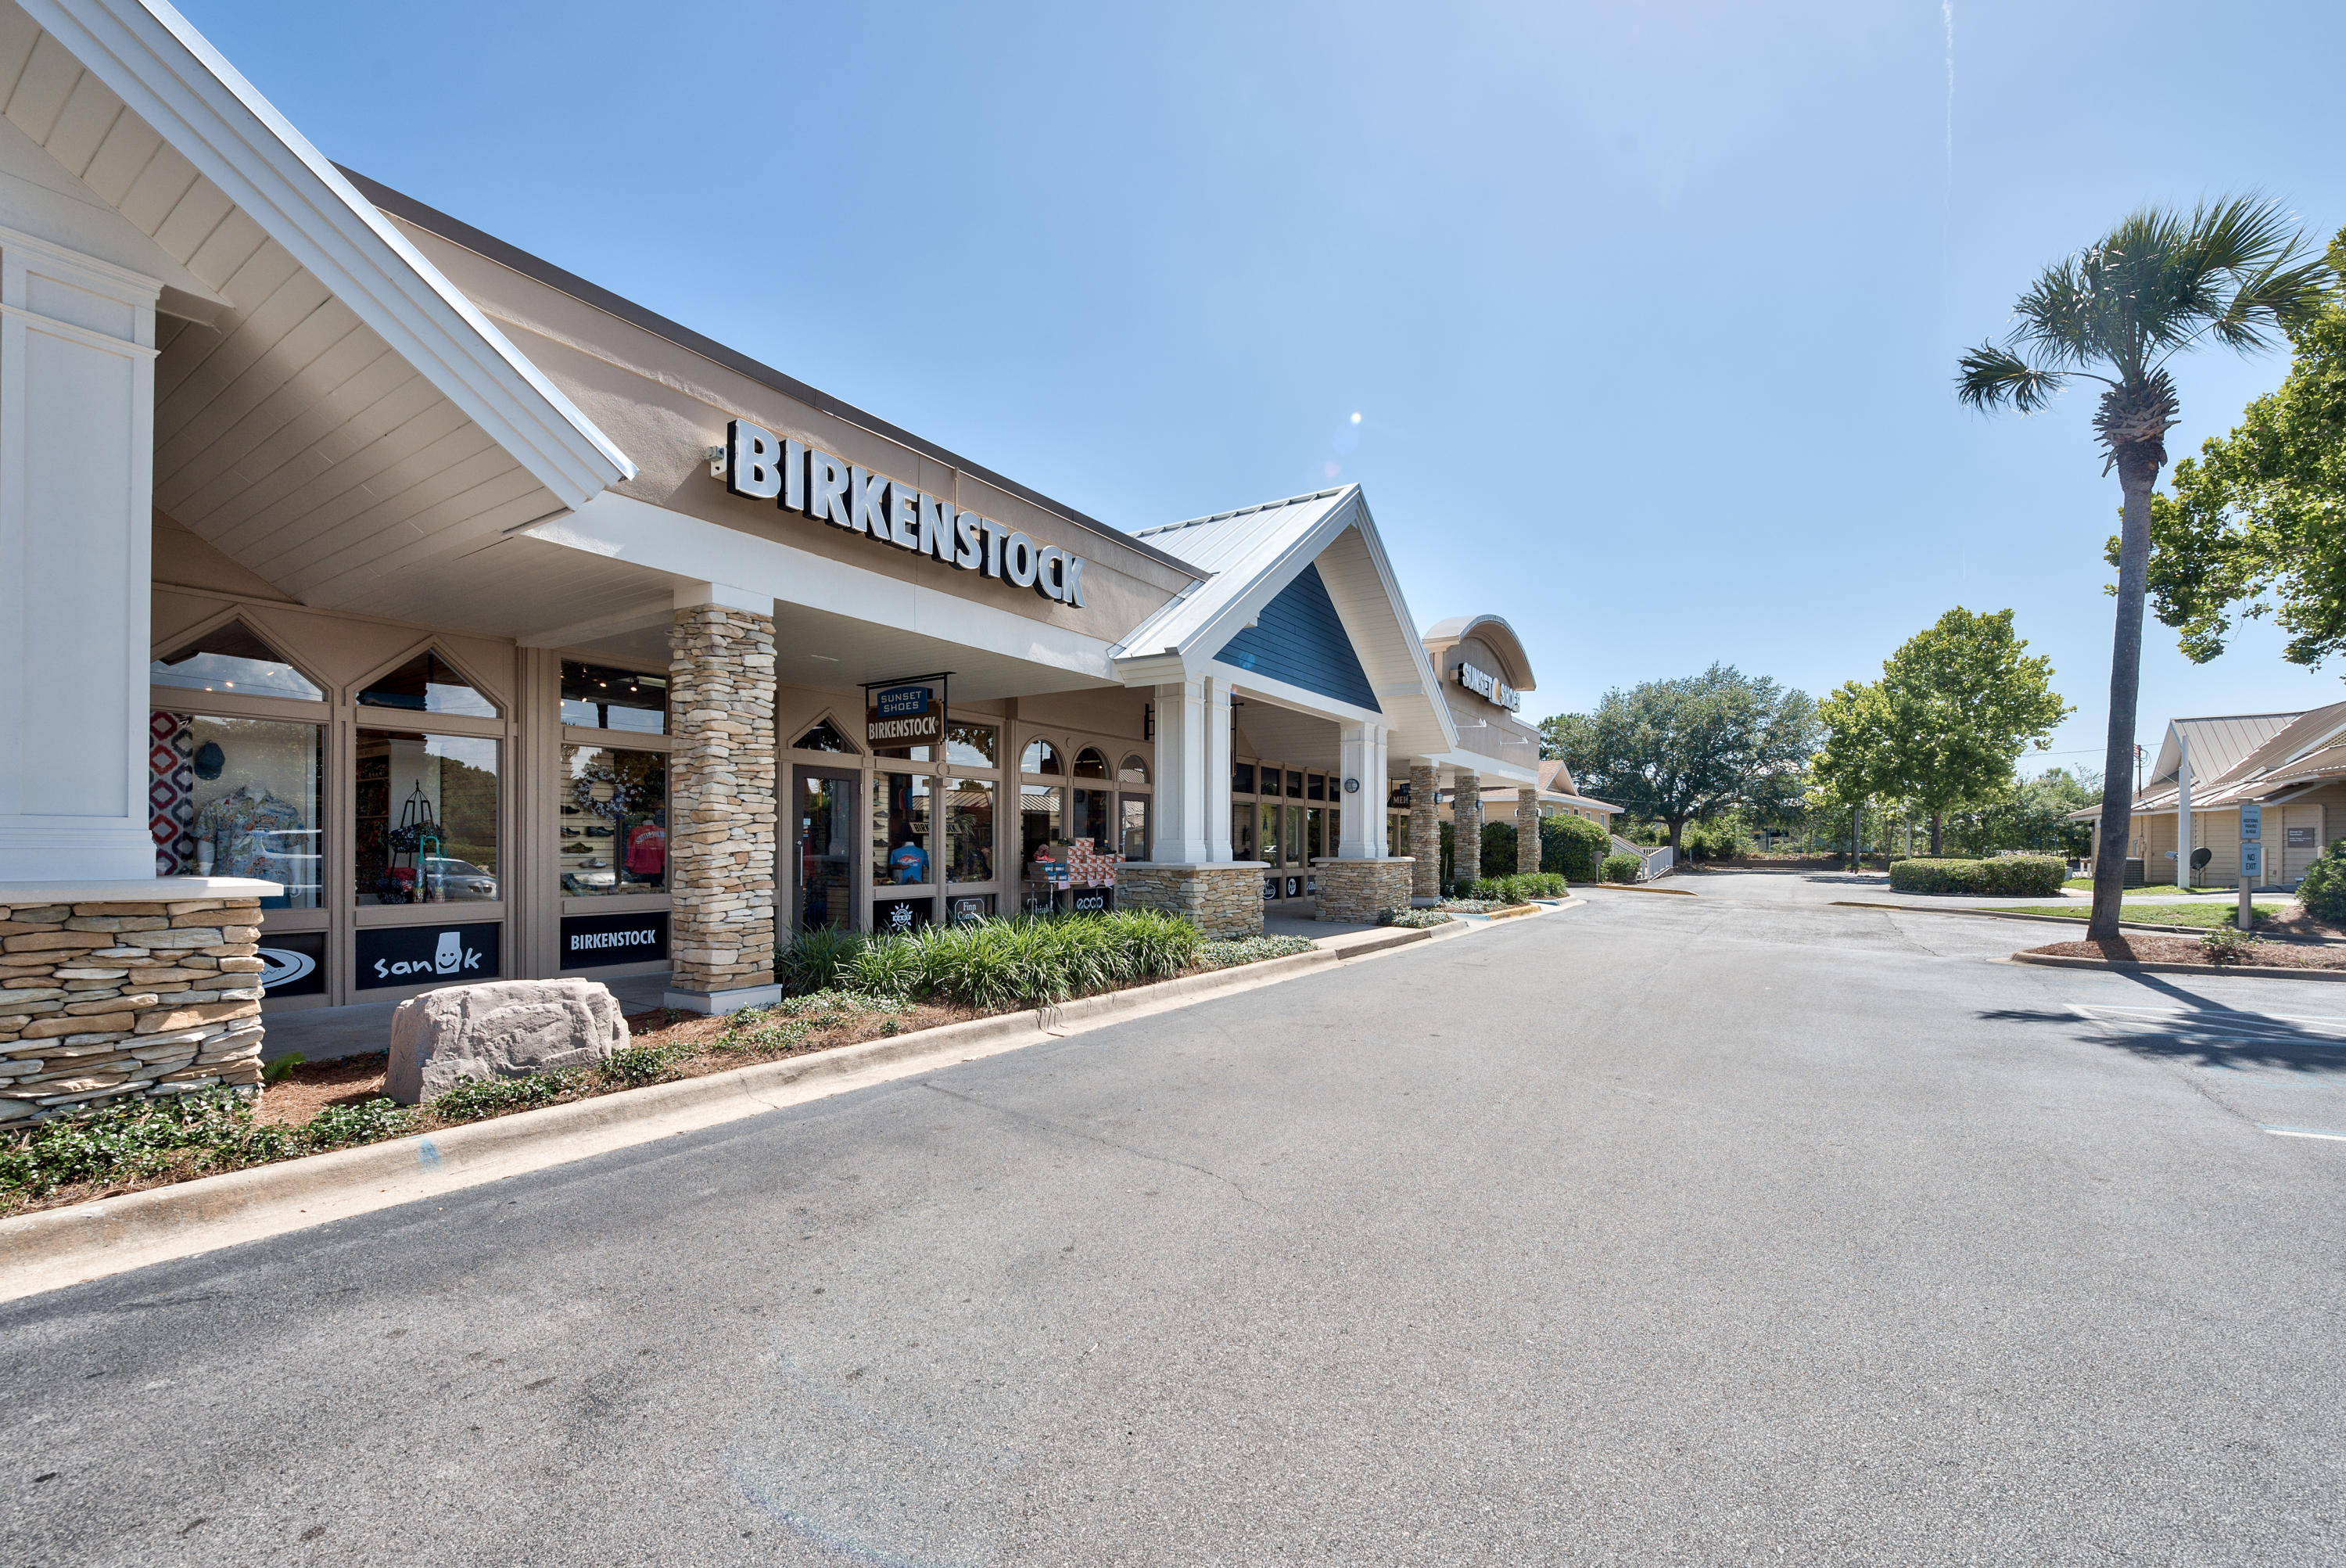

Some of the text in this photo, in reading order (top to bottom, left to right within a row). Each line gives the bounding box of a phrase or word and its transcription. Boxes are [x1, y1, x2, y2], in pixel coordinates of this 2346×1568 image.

[728, 418, 1087, 608] BIRKENSTOCK
[1459, 662, 1520, 712] SUNSET SHOES
[881, 691, 922, 703] SUNSET
[884, 701, 919, 712] SHOES
[963, 902, 977, 911] Finn
[1076, 896, 1103, 909] ecco
[571, 929, 656, 950] BIRKENSTOCK
